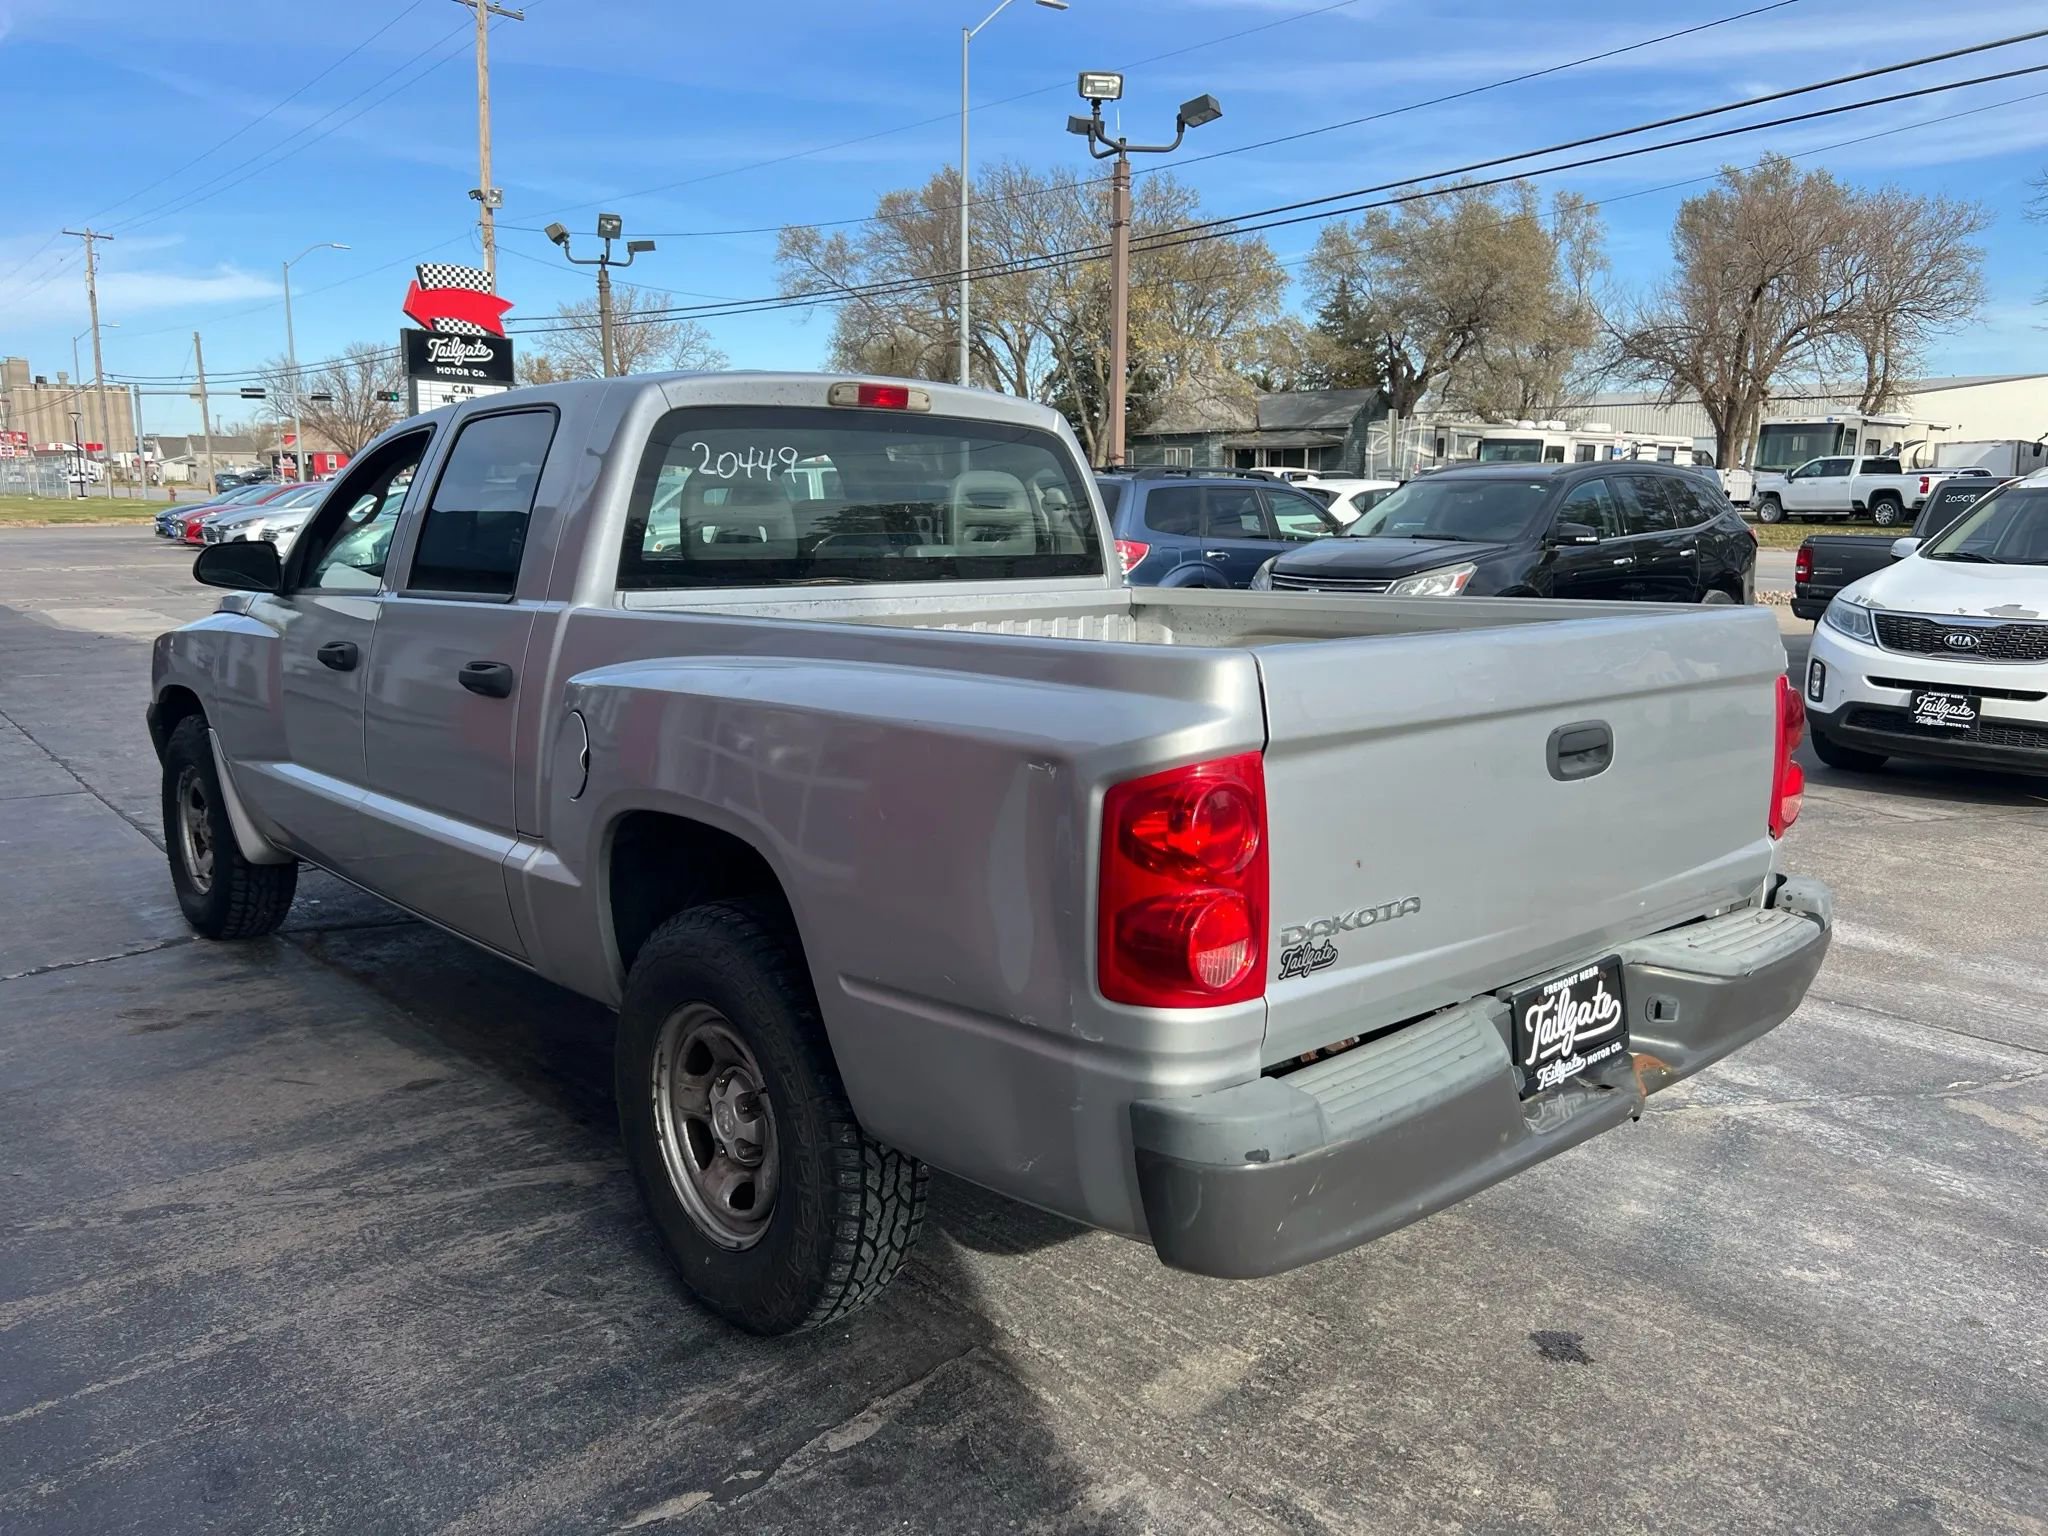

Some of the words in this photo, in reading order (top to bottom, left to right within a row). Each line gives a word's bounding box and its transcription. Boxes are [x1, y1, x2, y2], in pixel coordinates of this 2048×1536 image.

[427, 337, 494, 366] Tailgate
[436, 366, 469, 377] MOTOR
[472, 369, 487, 378] CO.
[441, 394, 456, 404] WE
[452, 385, 474, 395] CAN
[691, 442, 798, 484] 20449
[1945, 494, 1976, 503] 20508
[1949, 635, 1972, 646] KIA
[1913, 695, 1976, 720] Tailgate
[1280, 896, 1421, 947] DAKOTA
[1278, 939, 1338, 980] Tailgate
[1543, 974, 1579, 996] FREMONT
[1579, 965, 1599, 982] NEBR
[1525, 980, 1621, 1065] Tailgate
[1536, 1052, 1587, 1091] Tailgate
[1587, 1047, 1611, 1065] MOTOR
[1610, 1041, 1623, 1053] CO.
